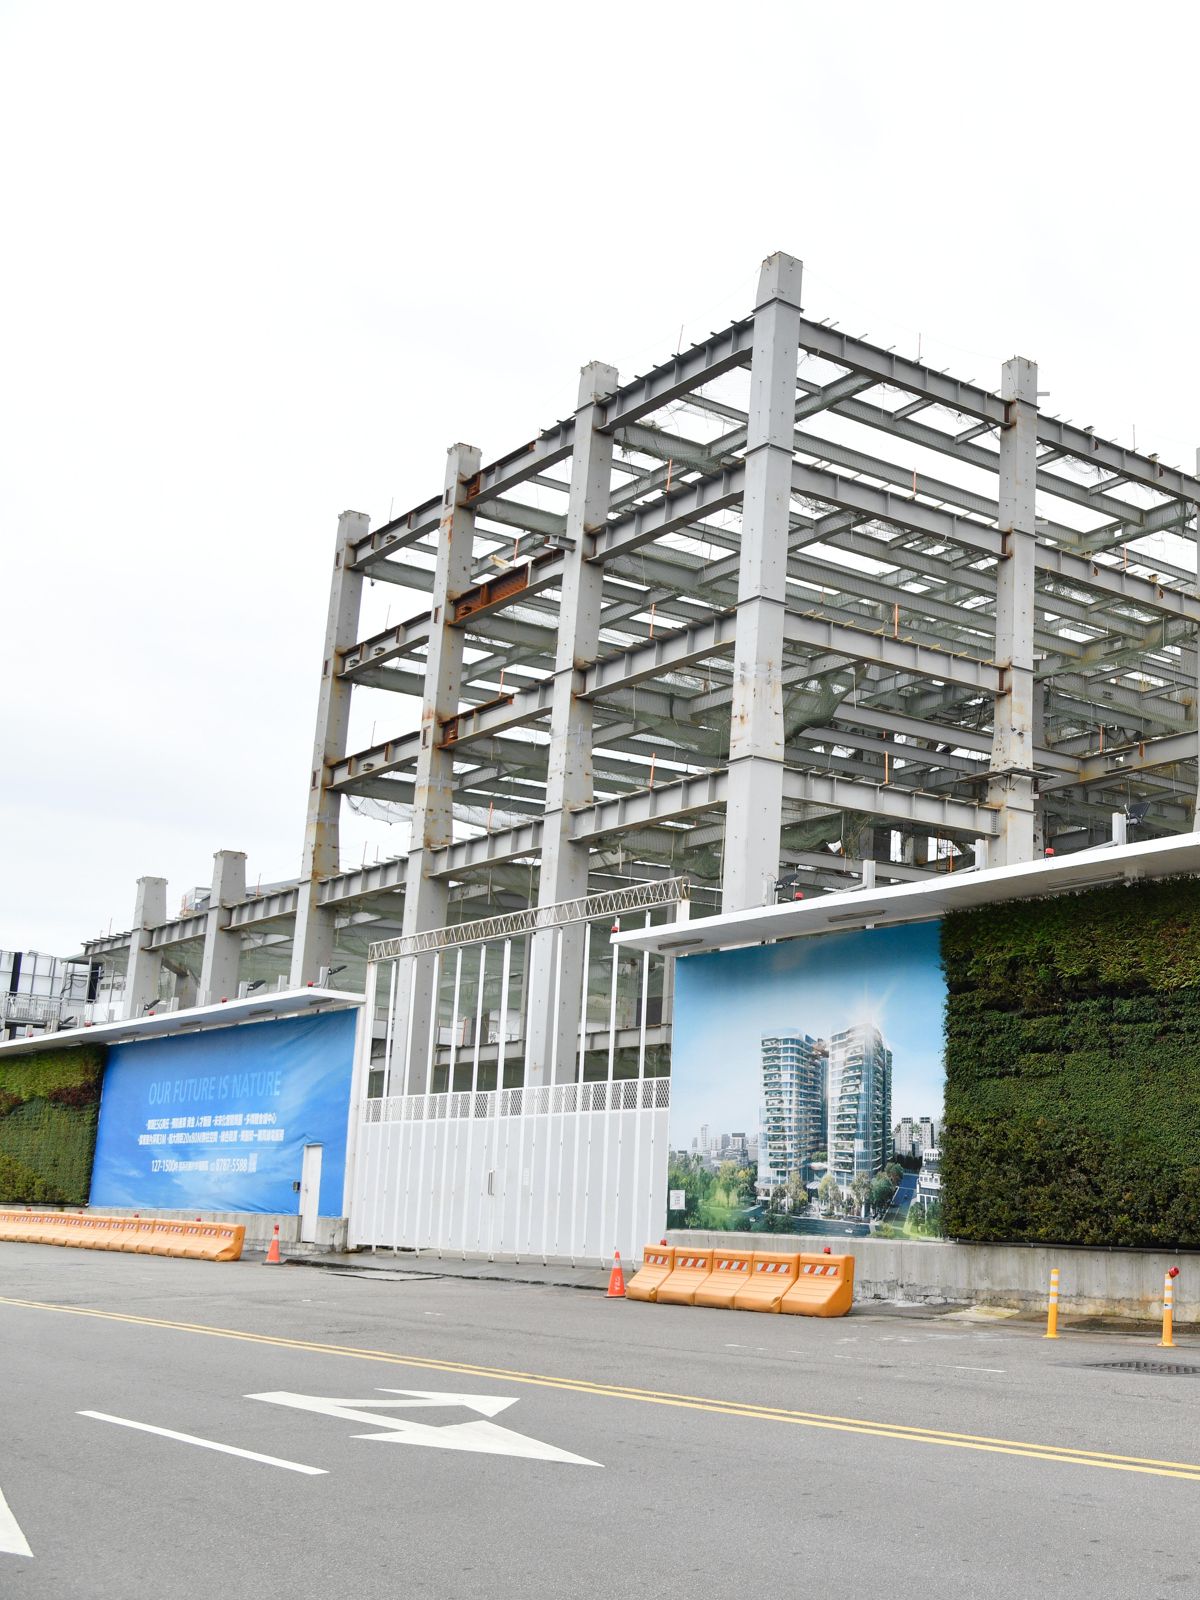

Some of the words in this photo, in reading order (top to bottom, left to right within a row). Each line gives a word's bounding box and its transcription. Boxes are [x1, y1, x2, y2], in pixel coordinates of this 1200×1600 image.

[149, 1081, 172, 1105] OUR
[173, 1076, 216, 1103] FUTURE
[217, 1075, 229, 1100] IS
[232, 1071, 282, 1098] NATURE
